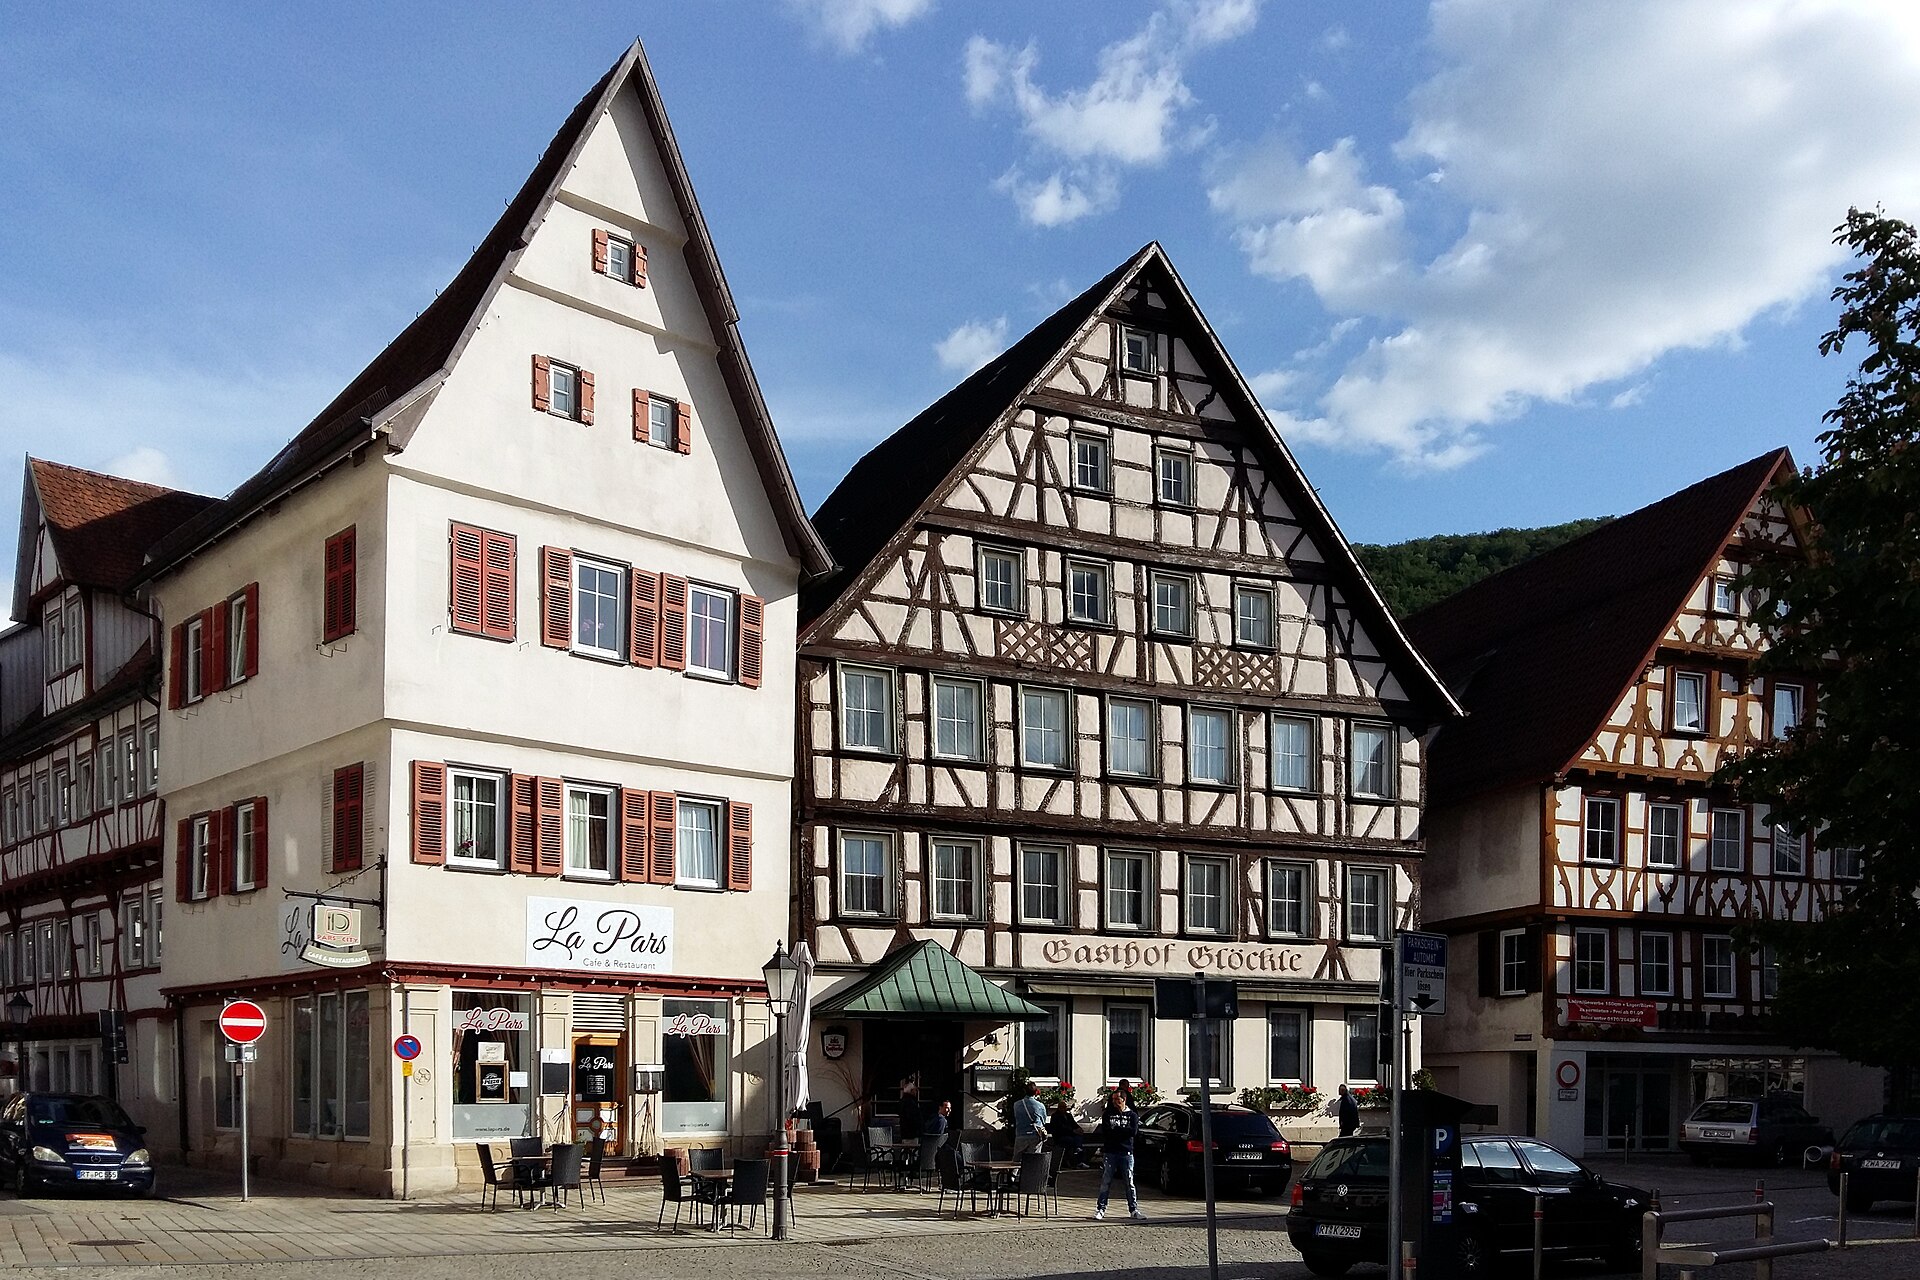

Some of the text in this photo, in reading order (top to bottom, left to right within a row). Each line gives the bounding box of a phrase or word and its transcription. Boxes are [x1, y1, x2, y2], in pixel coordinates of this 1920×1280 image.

[533, 906, 668, 960] La Pars
[1407, 936, 1443, 950] PARKSCHEIN-
[328, 956, 367, 964] RESTAURANT
[1042, 939, 1303, 972] Gasthof Glöckle
[1413, 951, 1437, 964] AUTOMAT
[605, 959, 611, 967] &
[614, 959, 656, 970] Restaurant
[1404, 966, 1444, 980] Hier Parkschein
[1417, 980, 1431, 991] lösen
[461, 1008, 523, 1034] La Pars
[668, 1014, 721, 1037] La Pars
[578, 1056, 614, 1071] La Pars
[1435, 1128, 1448, 1150] P
[1320, 1224, 1328, 1233] RT
[1340, 1226, 1360, 1237] 2935
